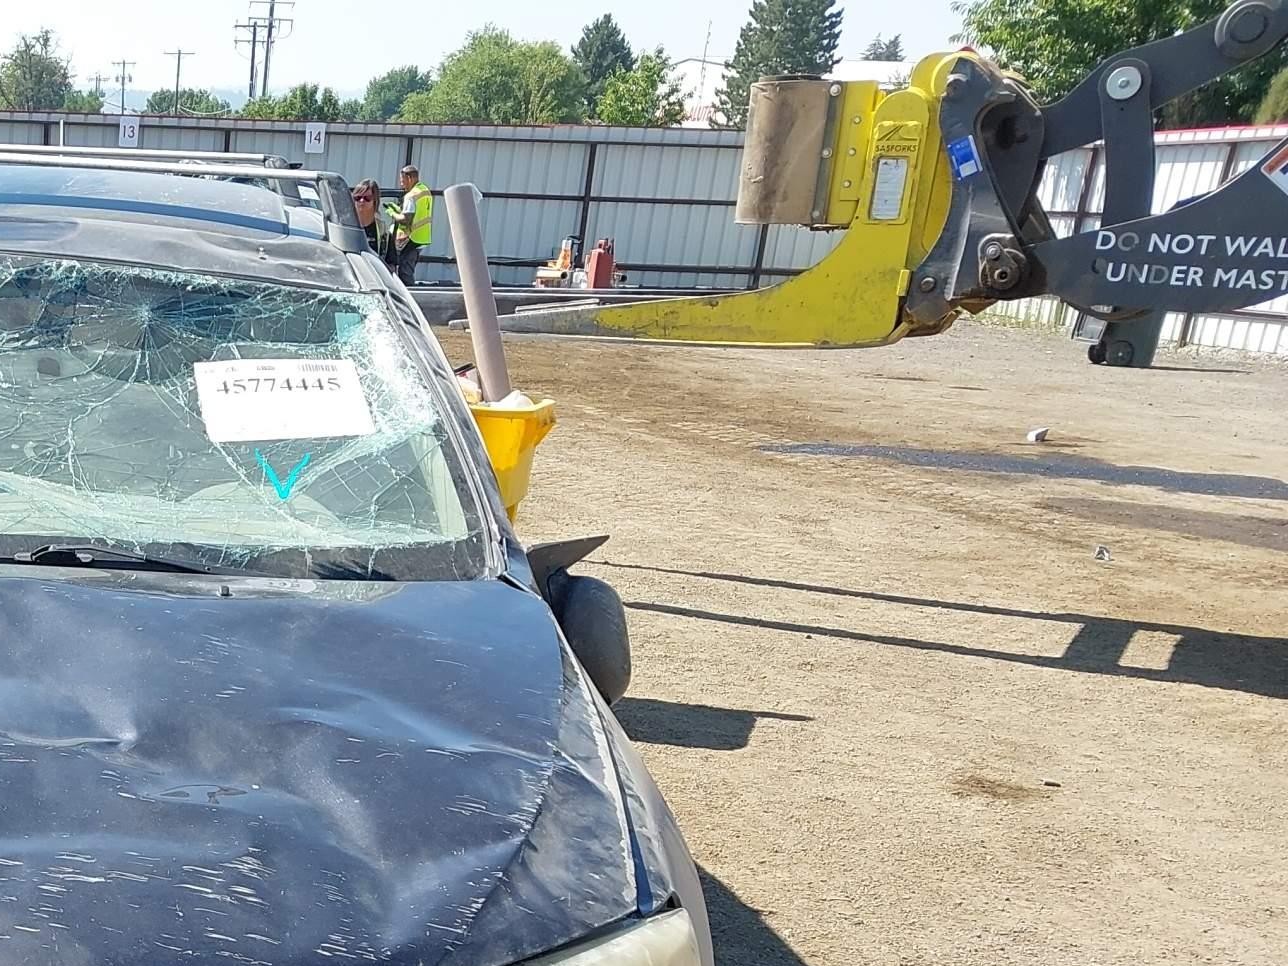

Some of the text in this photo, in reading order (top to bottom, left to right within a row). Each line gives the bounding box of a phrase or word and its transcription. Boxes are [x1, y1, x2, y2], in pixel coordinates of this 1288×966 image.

[123, 125, 136, 138] 13
[309, 130, 322, 145] 14
[875, 144, 918, 153] SASFORKS
[1095, 230, 1140, 251] DO
[1147, 233, 1216, 255] NOT
[1106, 262, 1288, 291] UNDER MAST
[216, 377, 341, 395] 45774445
